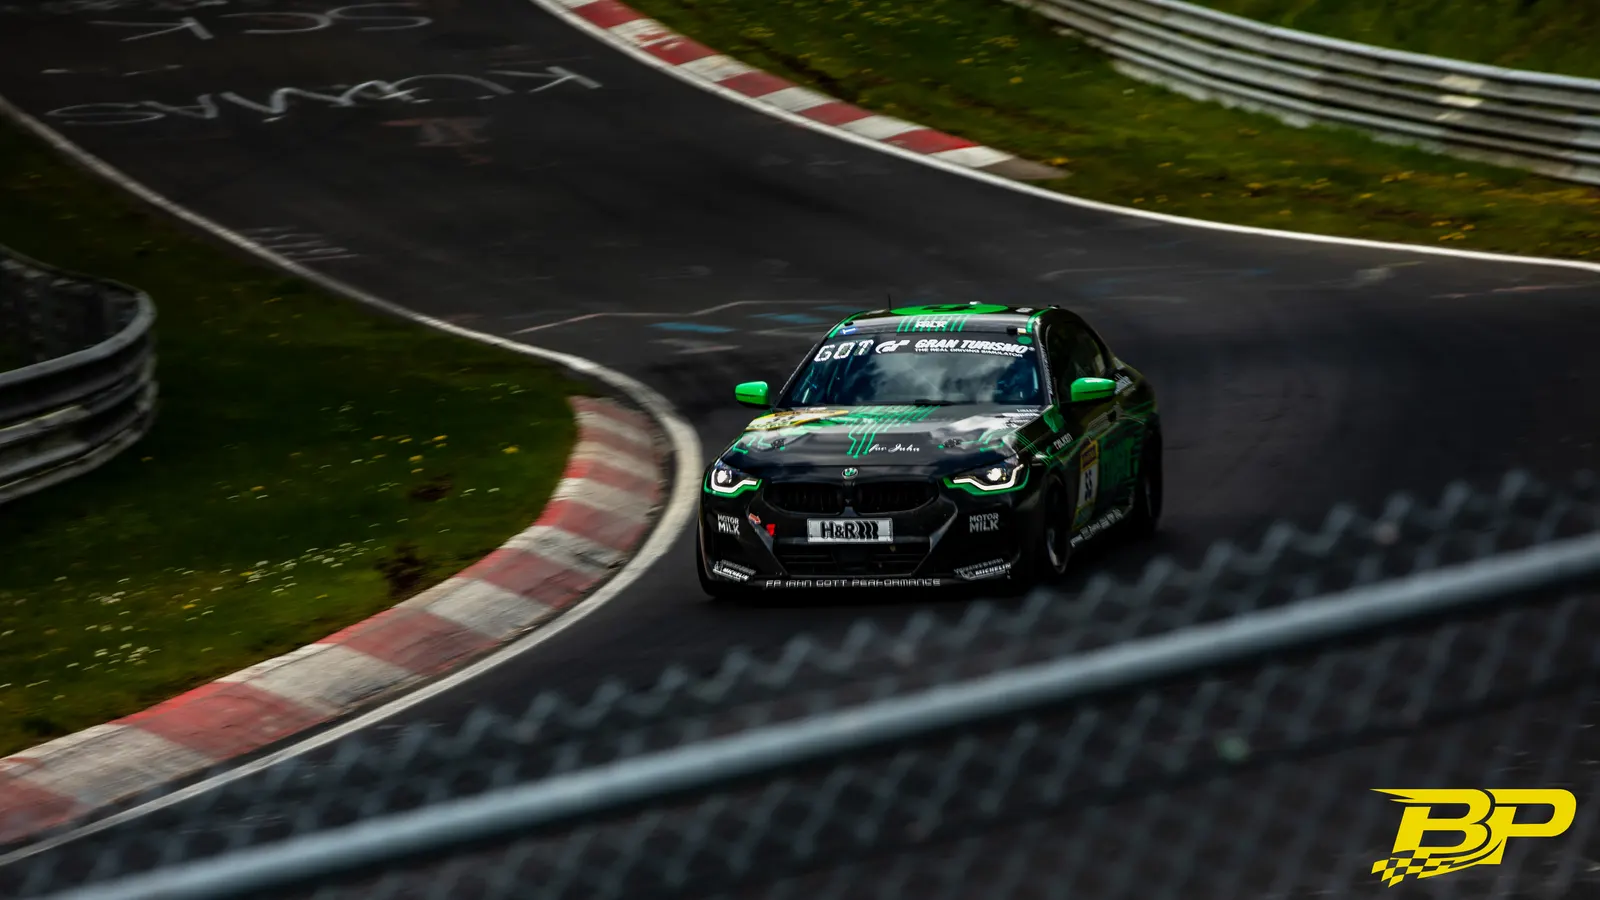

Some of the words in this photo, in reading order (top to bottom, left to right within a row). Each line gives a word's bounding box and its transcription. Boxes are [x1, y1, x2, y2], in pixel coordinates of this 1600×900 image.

[914, 339, 960, 349] GRAN
[981, 349, 1024, 358] SIMULATOR
[717, 514, 740, 524] MOTOR
[969, 512, 1000, 522] MOTOR
[718, 522, 741, 535] MILK
[969, 521, 1000, 533] MILK
[975, 562, 1012, 575] MICHELIN
[722, 567, 750, 581] MICHELIN
[816, 579, 848, 588] GOTT
[851, 578, 941, 588] PERFORMANCE
